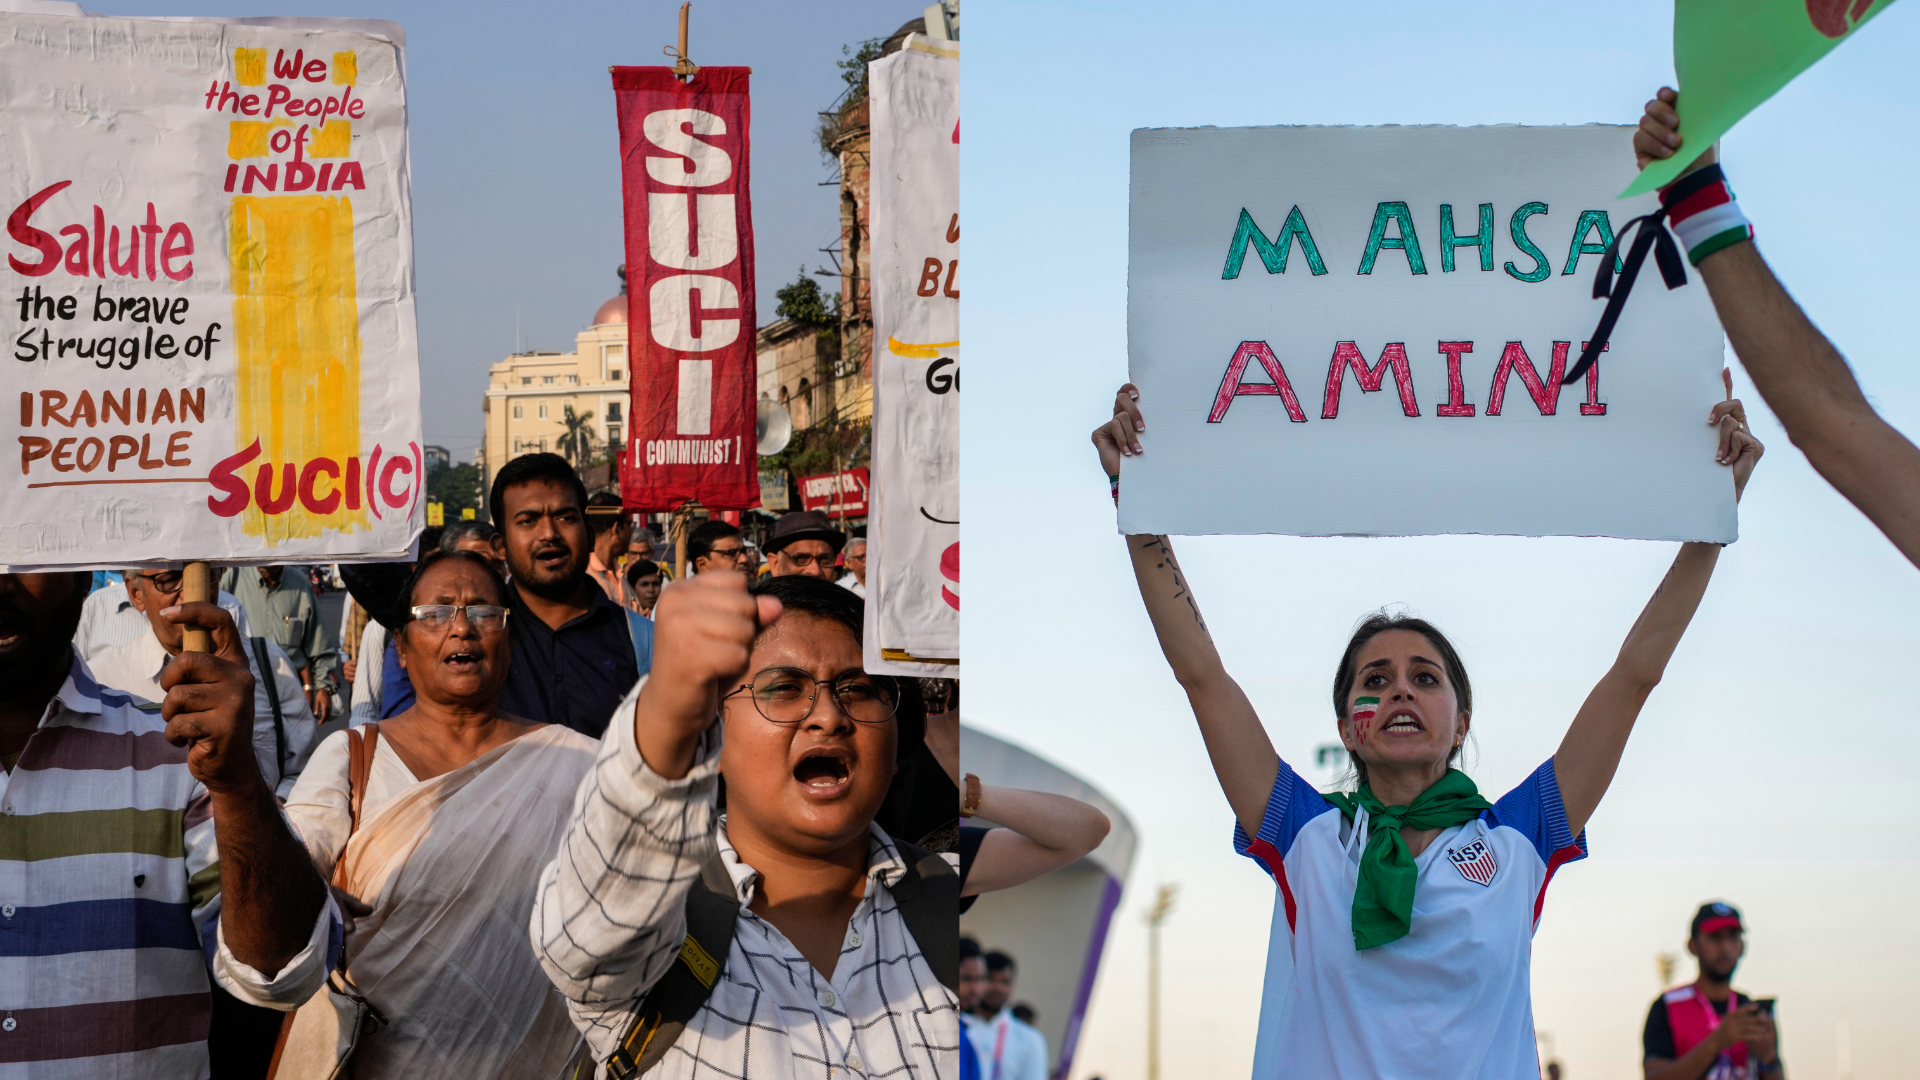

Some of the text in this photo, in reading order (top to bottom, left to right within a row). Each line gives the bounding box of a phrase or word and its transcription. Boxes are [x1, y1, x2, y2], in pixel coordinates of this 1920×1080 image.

[274, 49, 327, 82] We
[205, 80, 365, 128] the People
[270, 124, 309, 163] of
[224, 161, 365, 193] INDIA
[7, 180, 195, 282] Salute
[643, 108, 740, 435] SUCI
[16, 285, 189, 325] the brave
[14, 323, 221, 370] Struggle of
[1207, 340, 1609, 423] AMINI
[20, 387, 205, 427] IRANIAN
[18, 431, 192, 475] PEOPLE
[1452, 841, 1485, 862] USA
